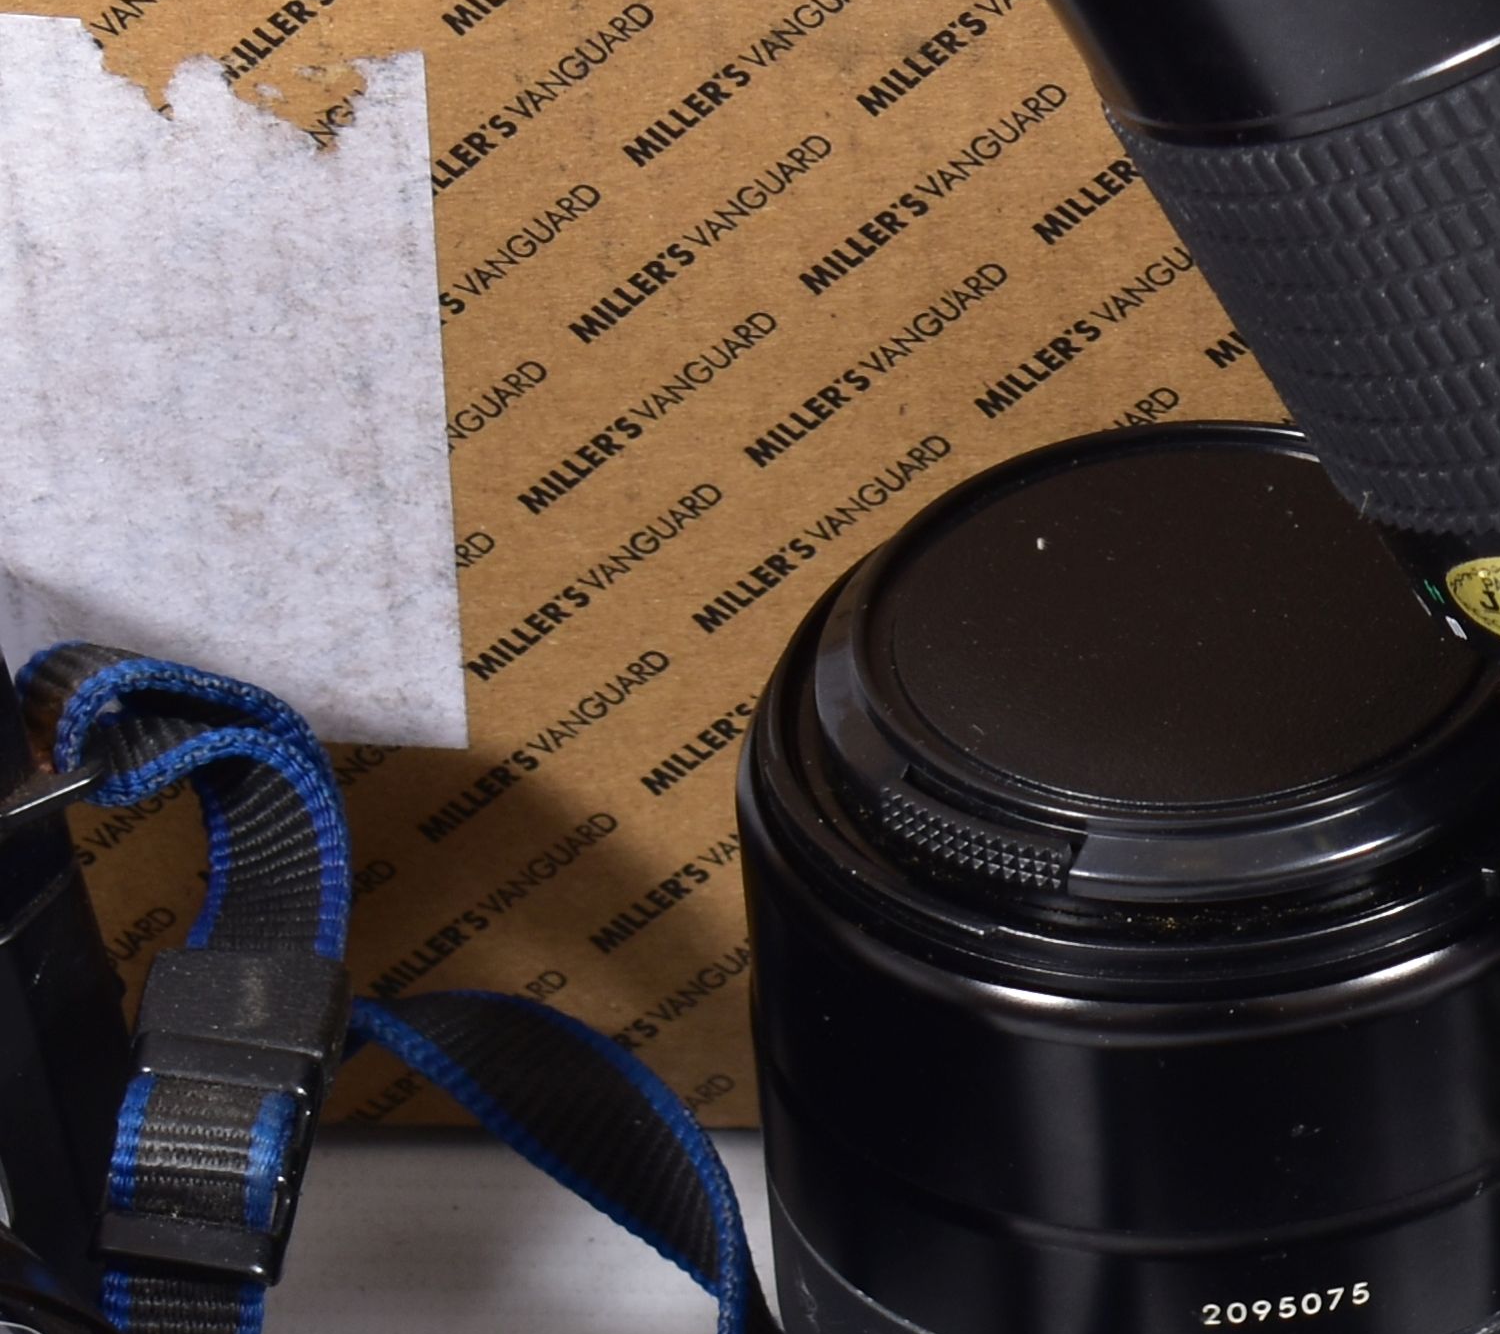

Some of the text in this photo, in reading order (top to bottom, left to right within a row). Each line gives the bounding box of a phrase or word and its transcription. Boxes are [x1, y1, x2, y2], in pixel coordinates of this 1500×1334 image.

[622, 63, 751, 168] MILLER'S
[798, 84, 1067, 296] MILLER'S VANGUARD
[567, 135, 832, 345] MILLER'S VANGUARD
[743, 263, 1008, 468] MILLER'S VANGUARD
[463, 484, 722, 681] MILLER'S VANGUARD
[691, 435, 951, 634] MILLER'S VANGUARD
[417, 650, 670, 843] MILLER'S VANGUARD
[369, 812, 618, 999] MILLER'S VANGUARD
[1200, 1281, 1373, 1327] 2095075
